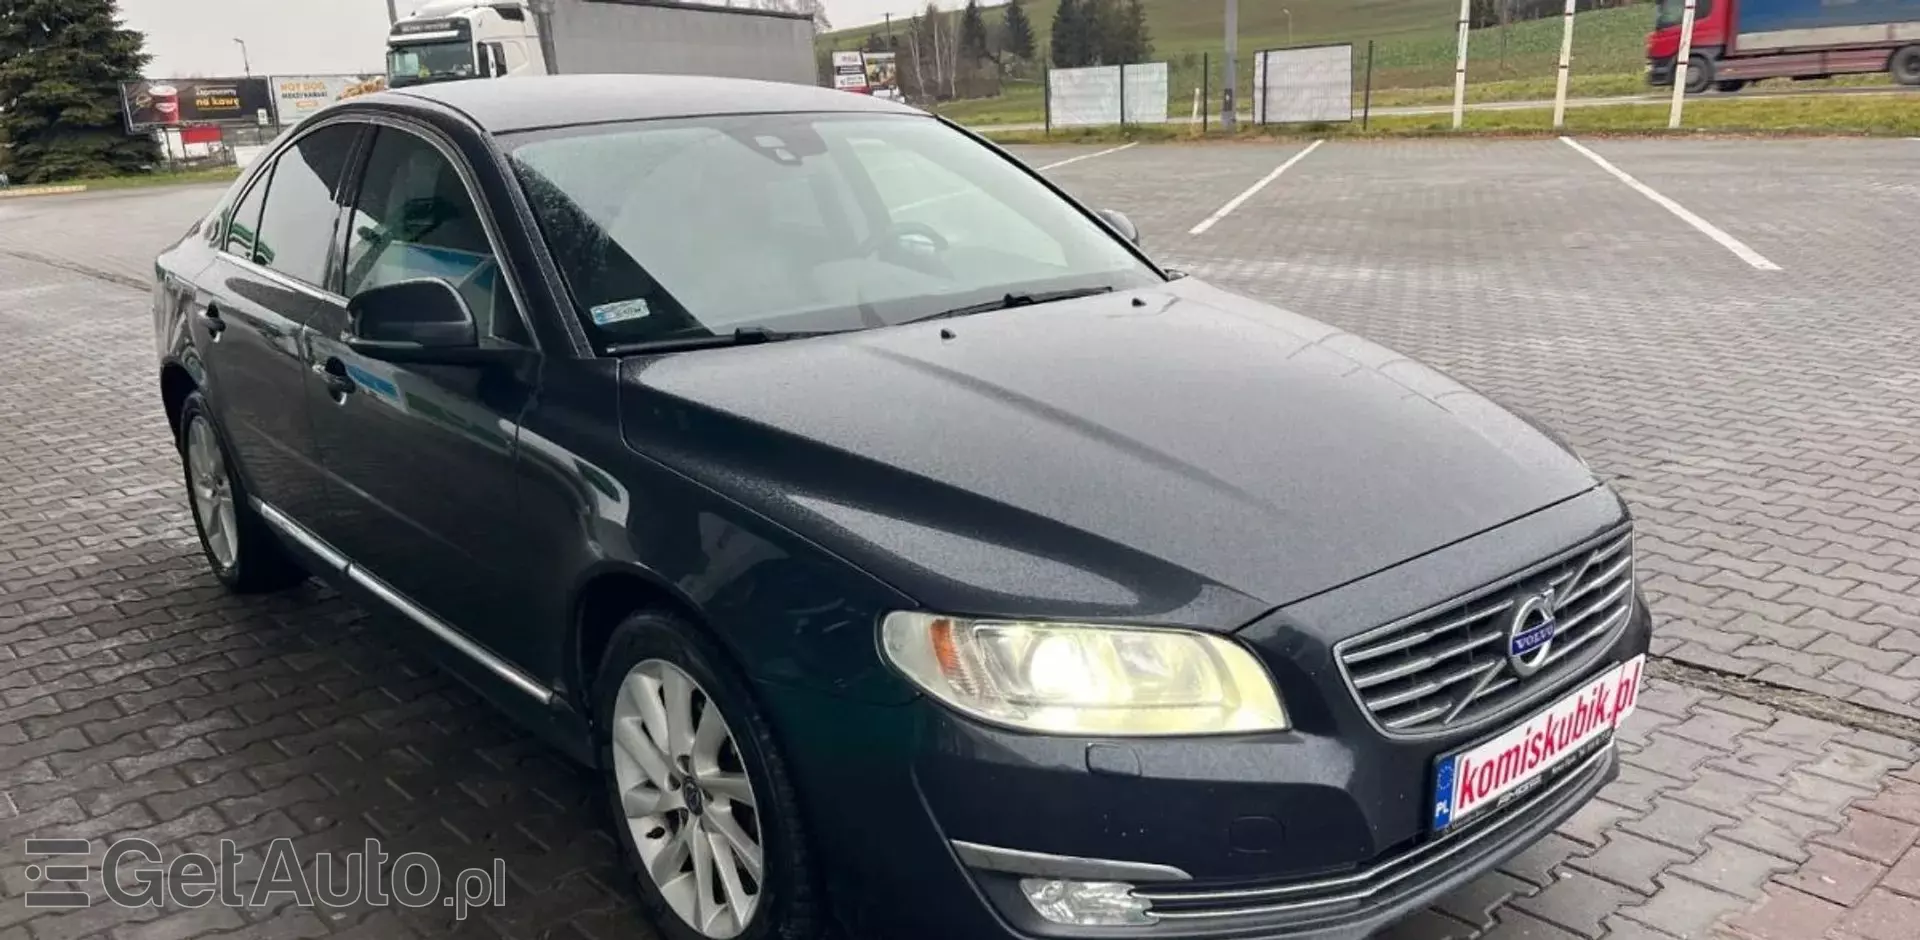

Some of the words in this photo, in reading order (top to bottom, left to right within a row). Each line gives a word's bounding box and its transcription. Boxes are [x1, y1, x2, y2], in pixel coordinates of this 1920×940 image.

[1515, 626, 1554, 649] VOLVO
[1457, 662, 1640, 809] komiskubik.pl
[1435, 801, 1451, 818] PL
